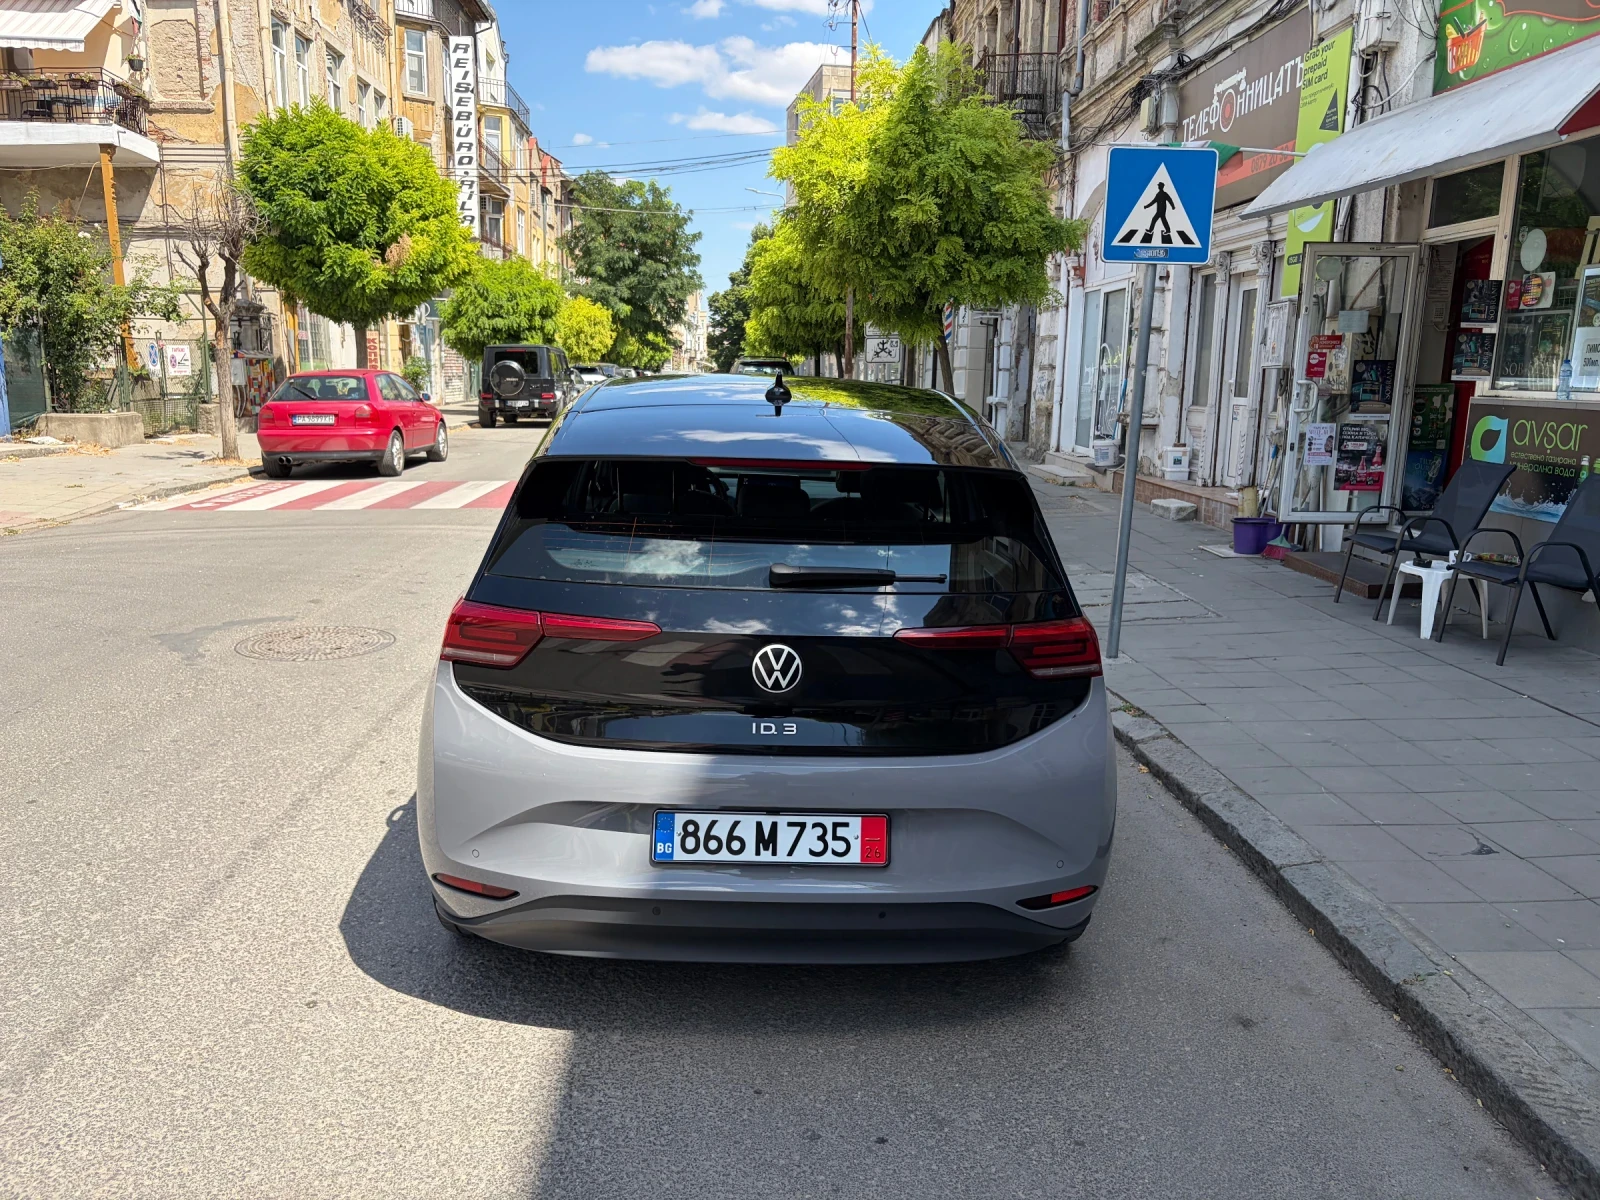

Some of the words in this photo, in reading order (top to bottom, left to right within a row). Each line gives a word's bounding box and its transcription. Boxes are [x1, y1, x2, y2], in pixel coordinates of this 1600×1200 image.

[1304, 49, 1320, 63] Grab
[1320, 40, 1336, 57] your
[1303, 55, 1328, 79] prepaid
[1302, 76, 1314, 91] SIM
[1314, 68, 1329, 84] card
[1510, 451, 1545, 462] естествено
[1545, 454, 1577, 466] газирана
[1554, 466, 1576, 478] вода
[752, 722, 797, 735] ID.3
[656, 843, 673, 854] BG
[680, 819, 747, 856] 866
[754, 820, 778, 857] M
[786, 821, 852, 858] 735
[865, 845, 882, 859] 26
